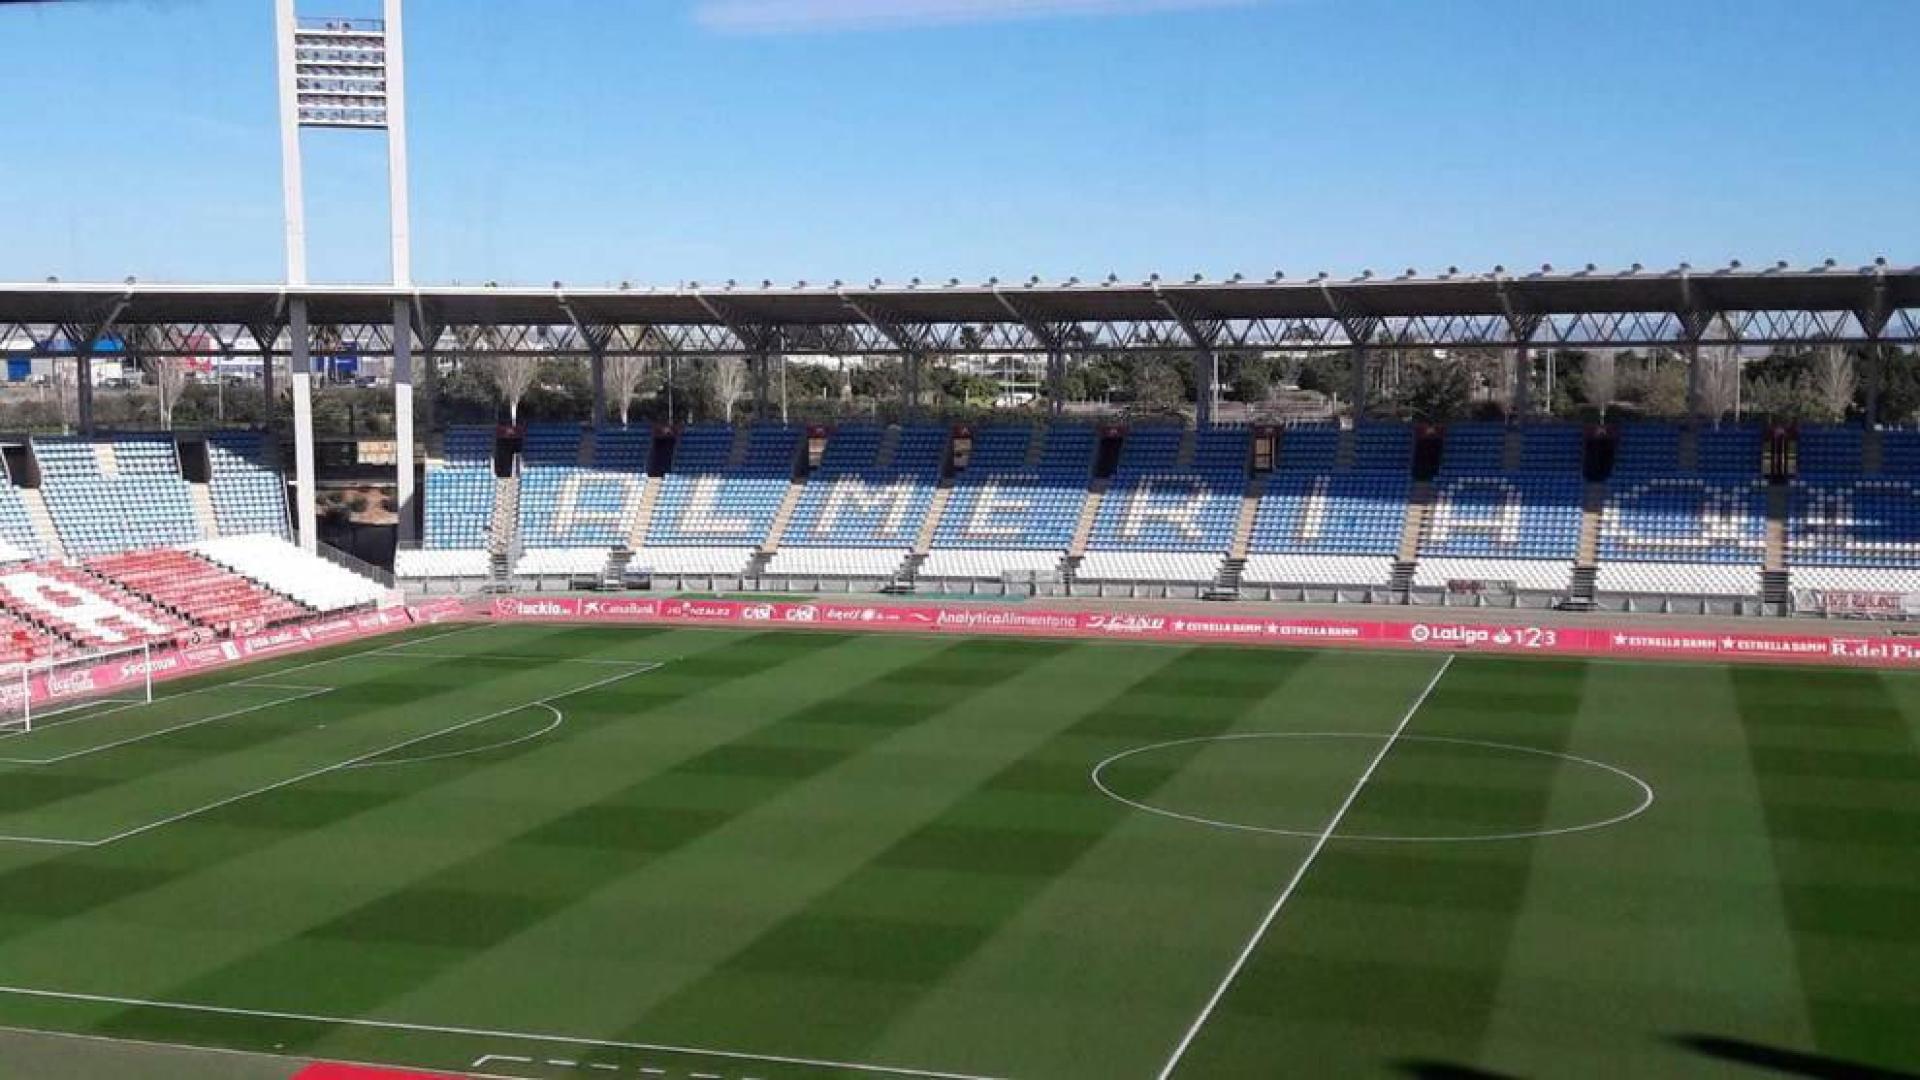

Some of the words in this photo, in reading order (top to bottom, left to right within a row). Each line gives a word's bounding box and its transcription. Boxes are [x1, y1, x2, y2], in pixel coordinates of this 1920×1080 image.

[552, 471, 1522, 541] ALMERIA
[1186, 622, 1232, 633] ESTRELLA
[1280, 625, 1327, 635] ESTRELLA
[1432, 625, 1489, 644] LaLiga
[1513, 627, 1557, 648] 123
[1628, 636, 1680, 648] ESTRELLA
[1682, 639, 1716, 649] DAMM
[1737, 639, 1789, 651] ESTRELLA
[1791, 641, 1827, 652] DAMM
